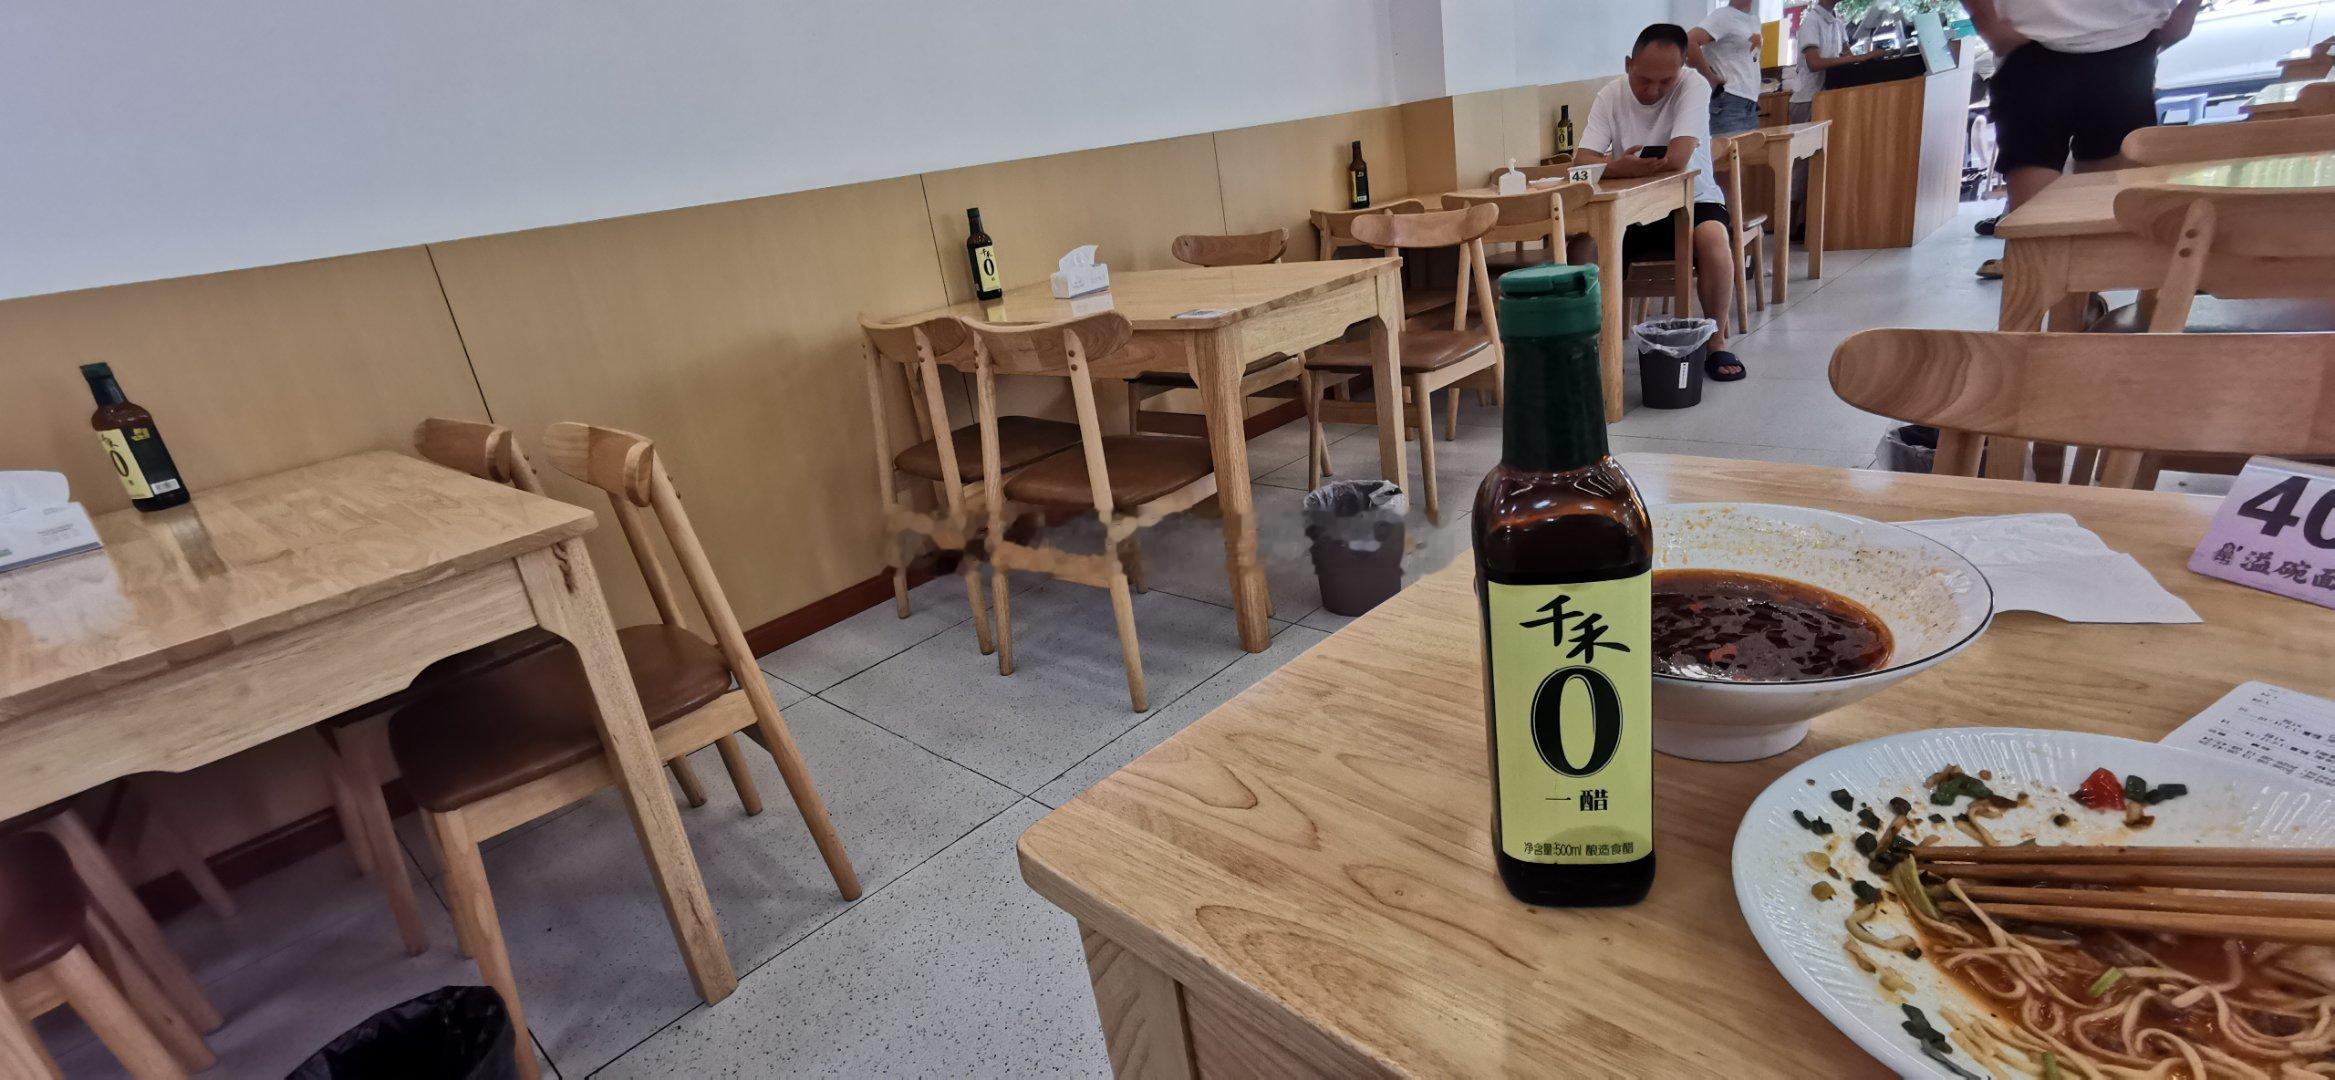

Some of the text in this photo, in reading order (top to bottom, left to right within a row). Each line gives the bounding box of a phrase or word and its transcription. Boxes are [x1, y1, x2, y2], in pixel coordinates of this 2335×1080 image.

[1572, 170, 1588, 181] 43
[1519, 594, 1631, 664] 千禾
[1530, 665, 1623, 778] 0
